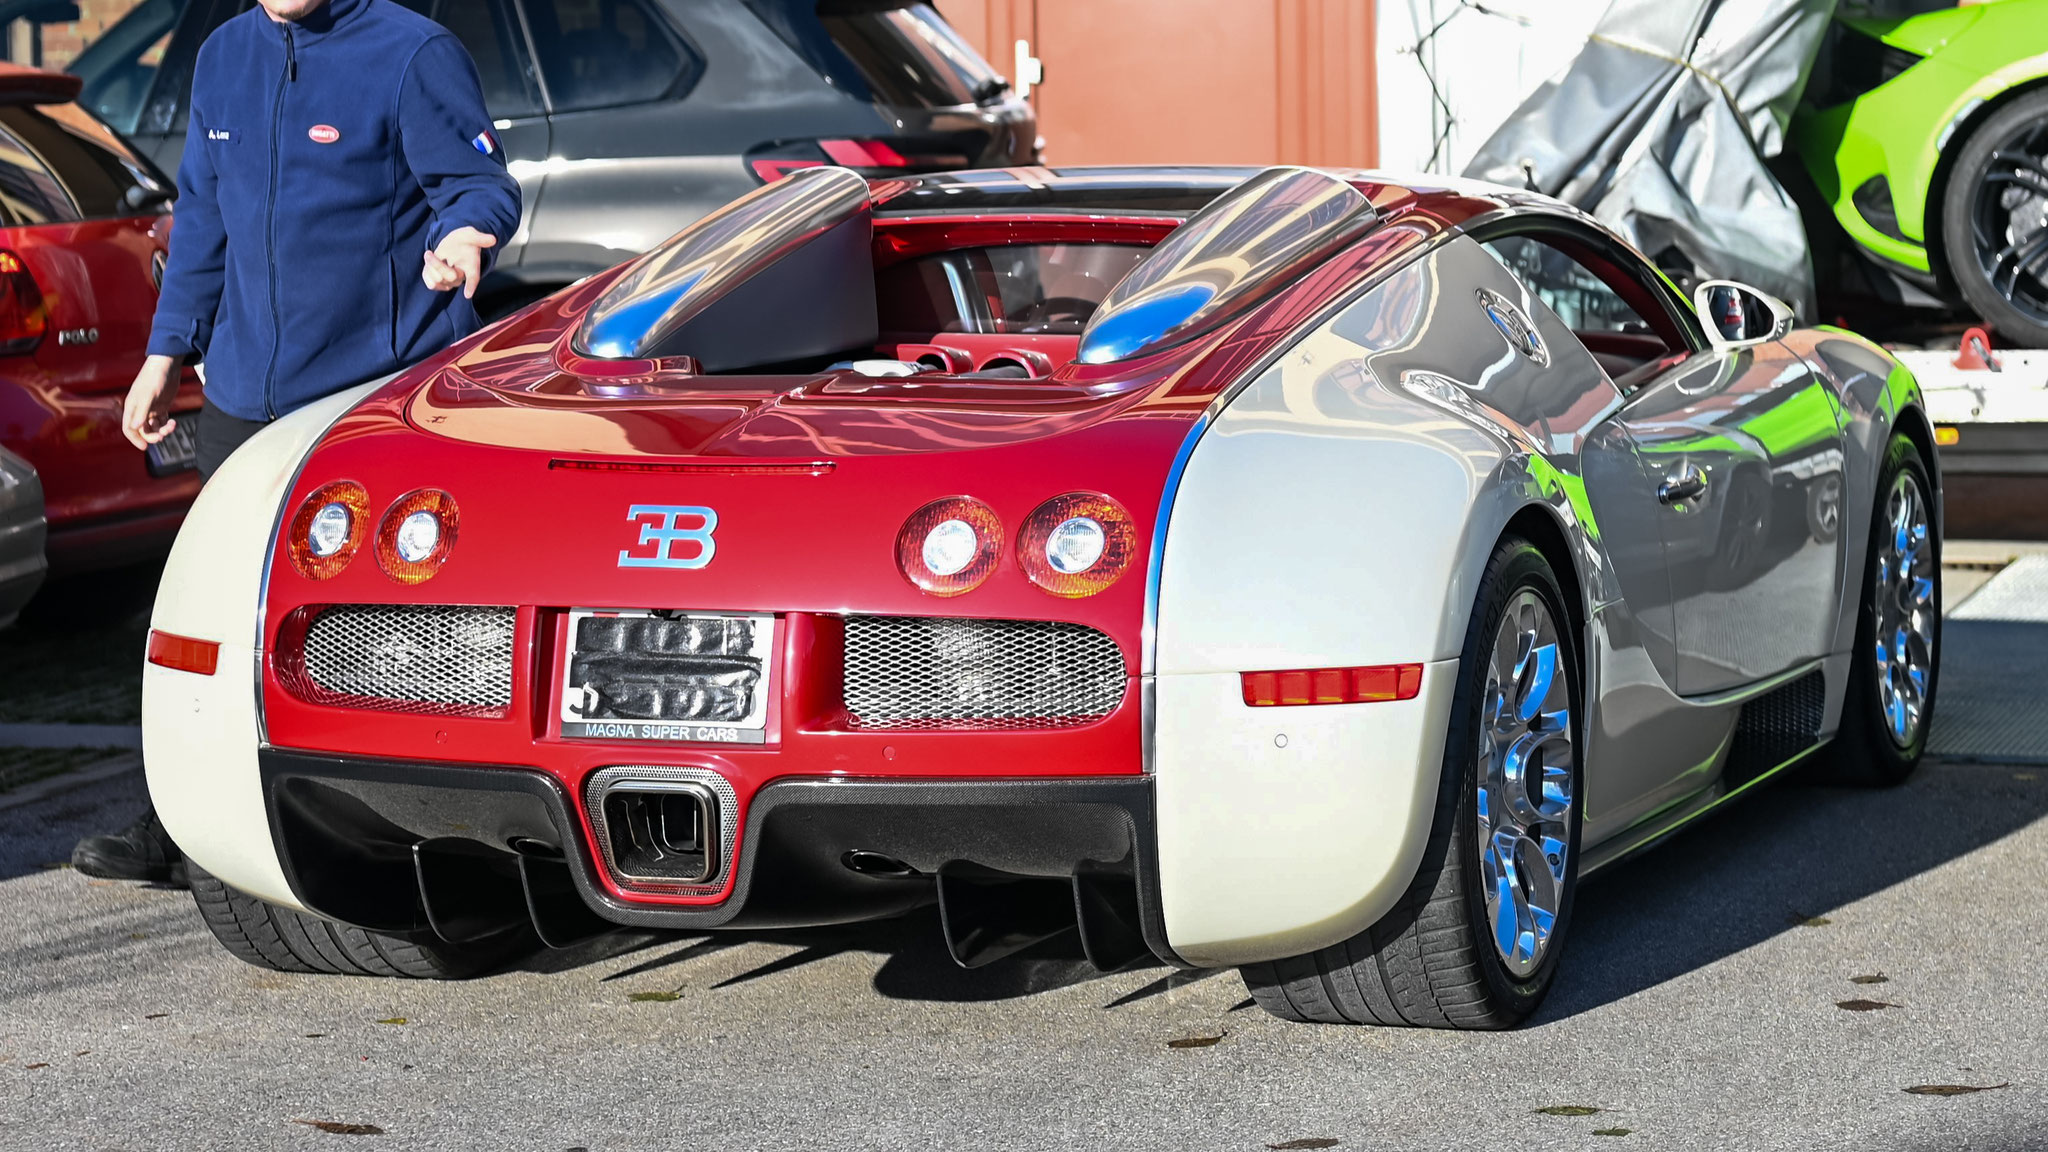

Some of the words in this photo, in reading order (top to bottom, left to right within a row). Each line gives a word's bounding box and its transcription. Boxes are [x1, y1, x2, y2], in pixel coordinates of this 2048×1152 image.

[585, 723, 635, 738] MAGNA
[641, 725, 690, 740] SUPER
[696, 726, 738, 742] CARS
